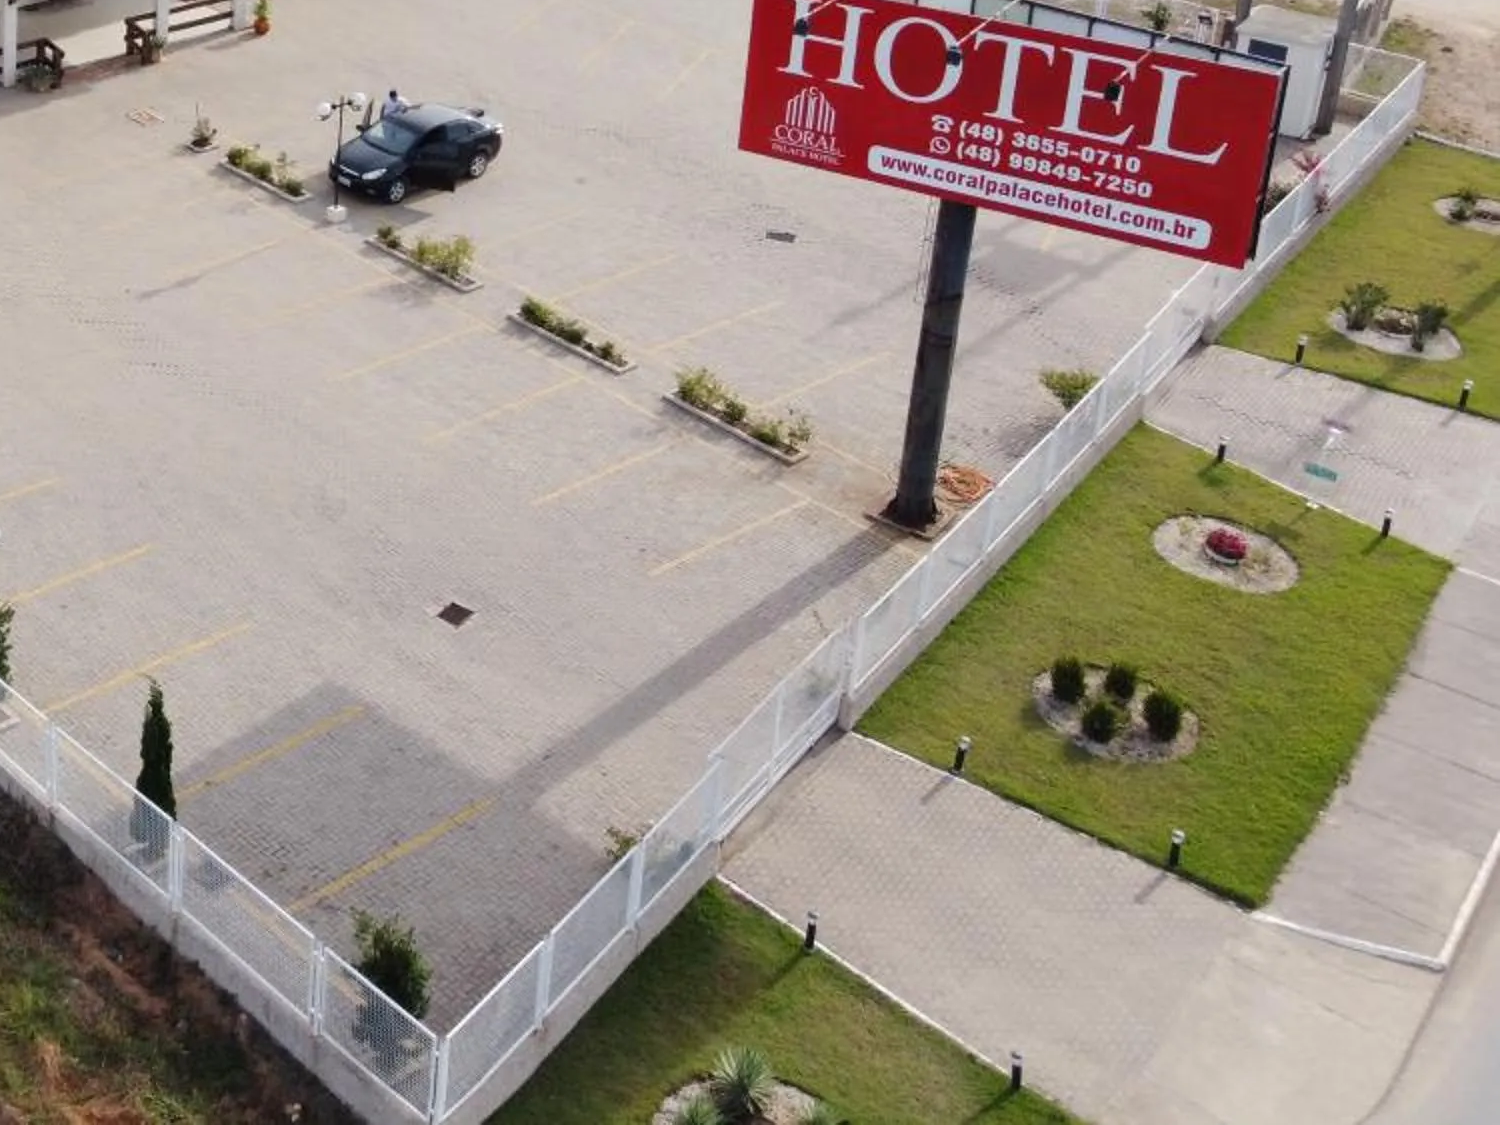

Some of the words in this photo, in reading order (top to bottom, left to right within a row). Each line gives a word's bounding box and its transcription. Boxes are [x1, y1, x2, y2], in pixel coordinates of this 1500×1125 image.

[956, 146, 1000, 168] (48)
[1008, 154, 1152, 198] 99849-7250
[960, 121, 1004, 146] (48)
[1011, 131, 1141, 173] 3655-0710
[881, 154, 1197, 241] www.coralpalacehotel.com.br
